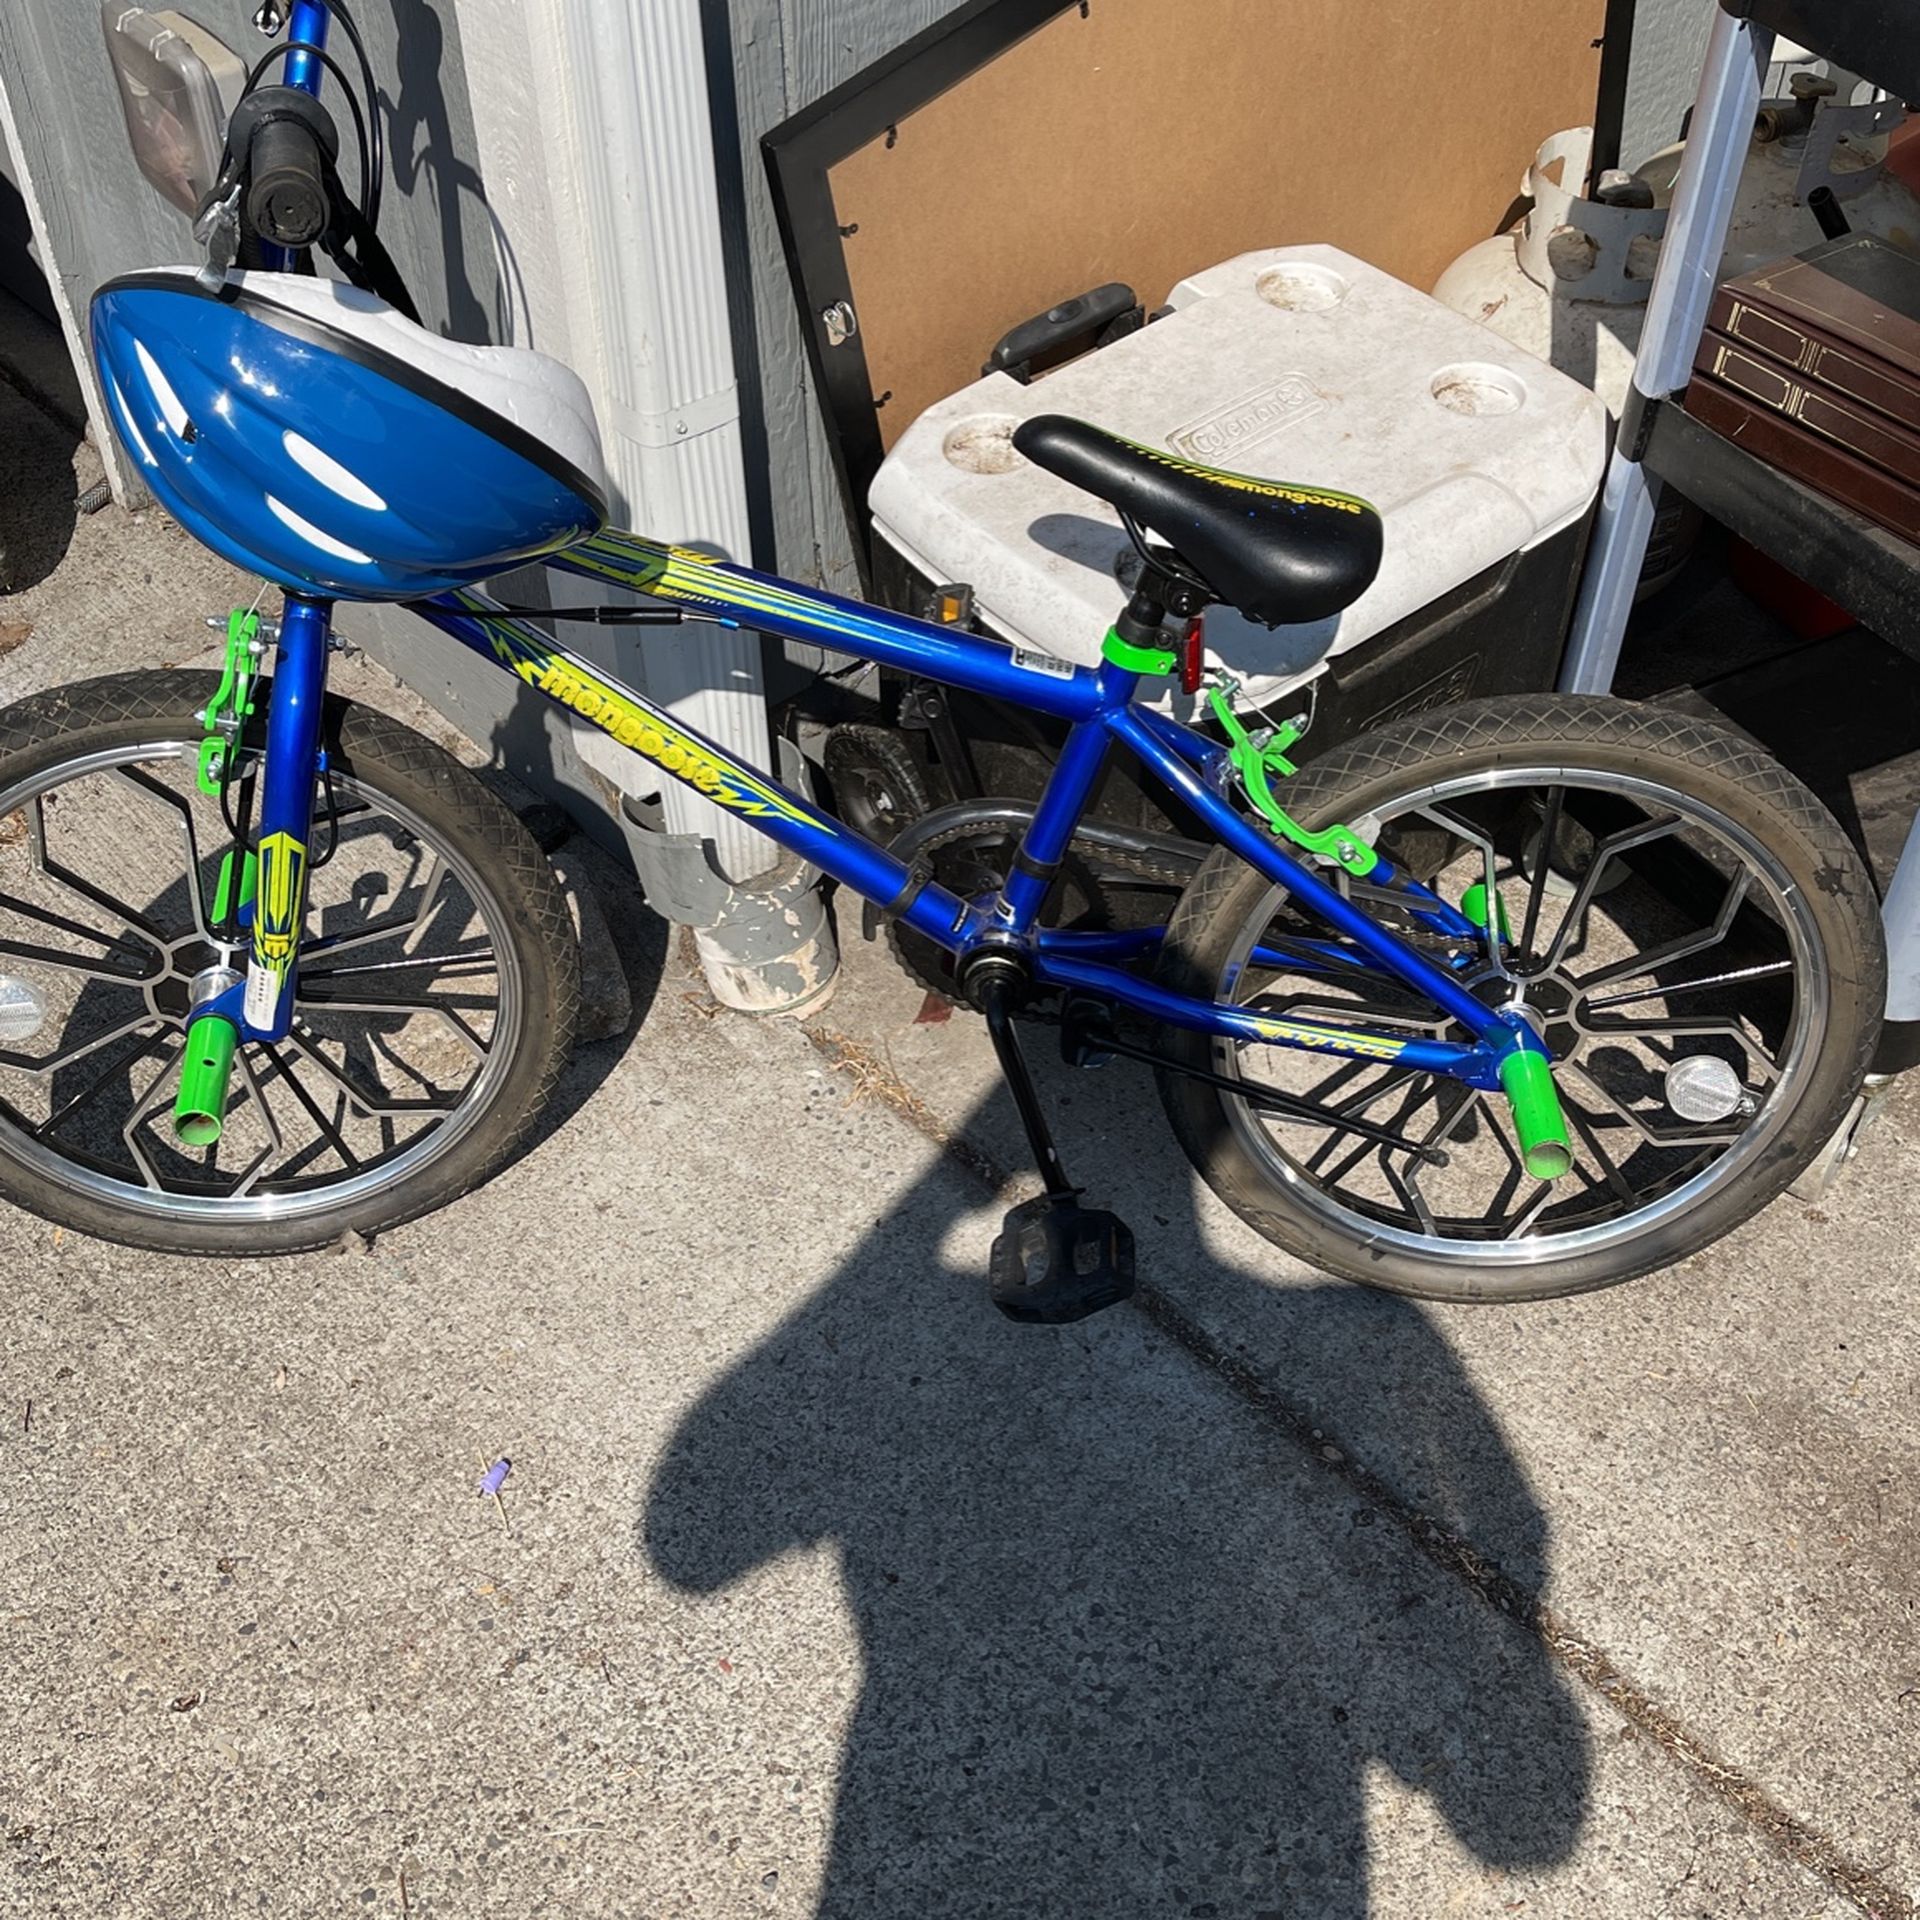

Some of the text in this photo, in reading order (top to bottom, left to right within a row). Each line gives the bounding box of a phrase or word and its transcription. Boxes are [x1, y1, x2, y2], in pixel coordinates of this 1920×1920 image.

[1191, 400, 1284, 455] Coleman
[1240, 482, 1361, 514] mongoose
[537, 666, 721, 793] mongoose
